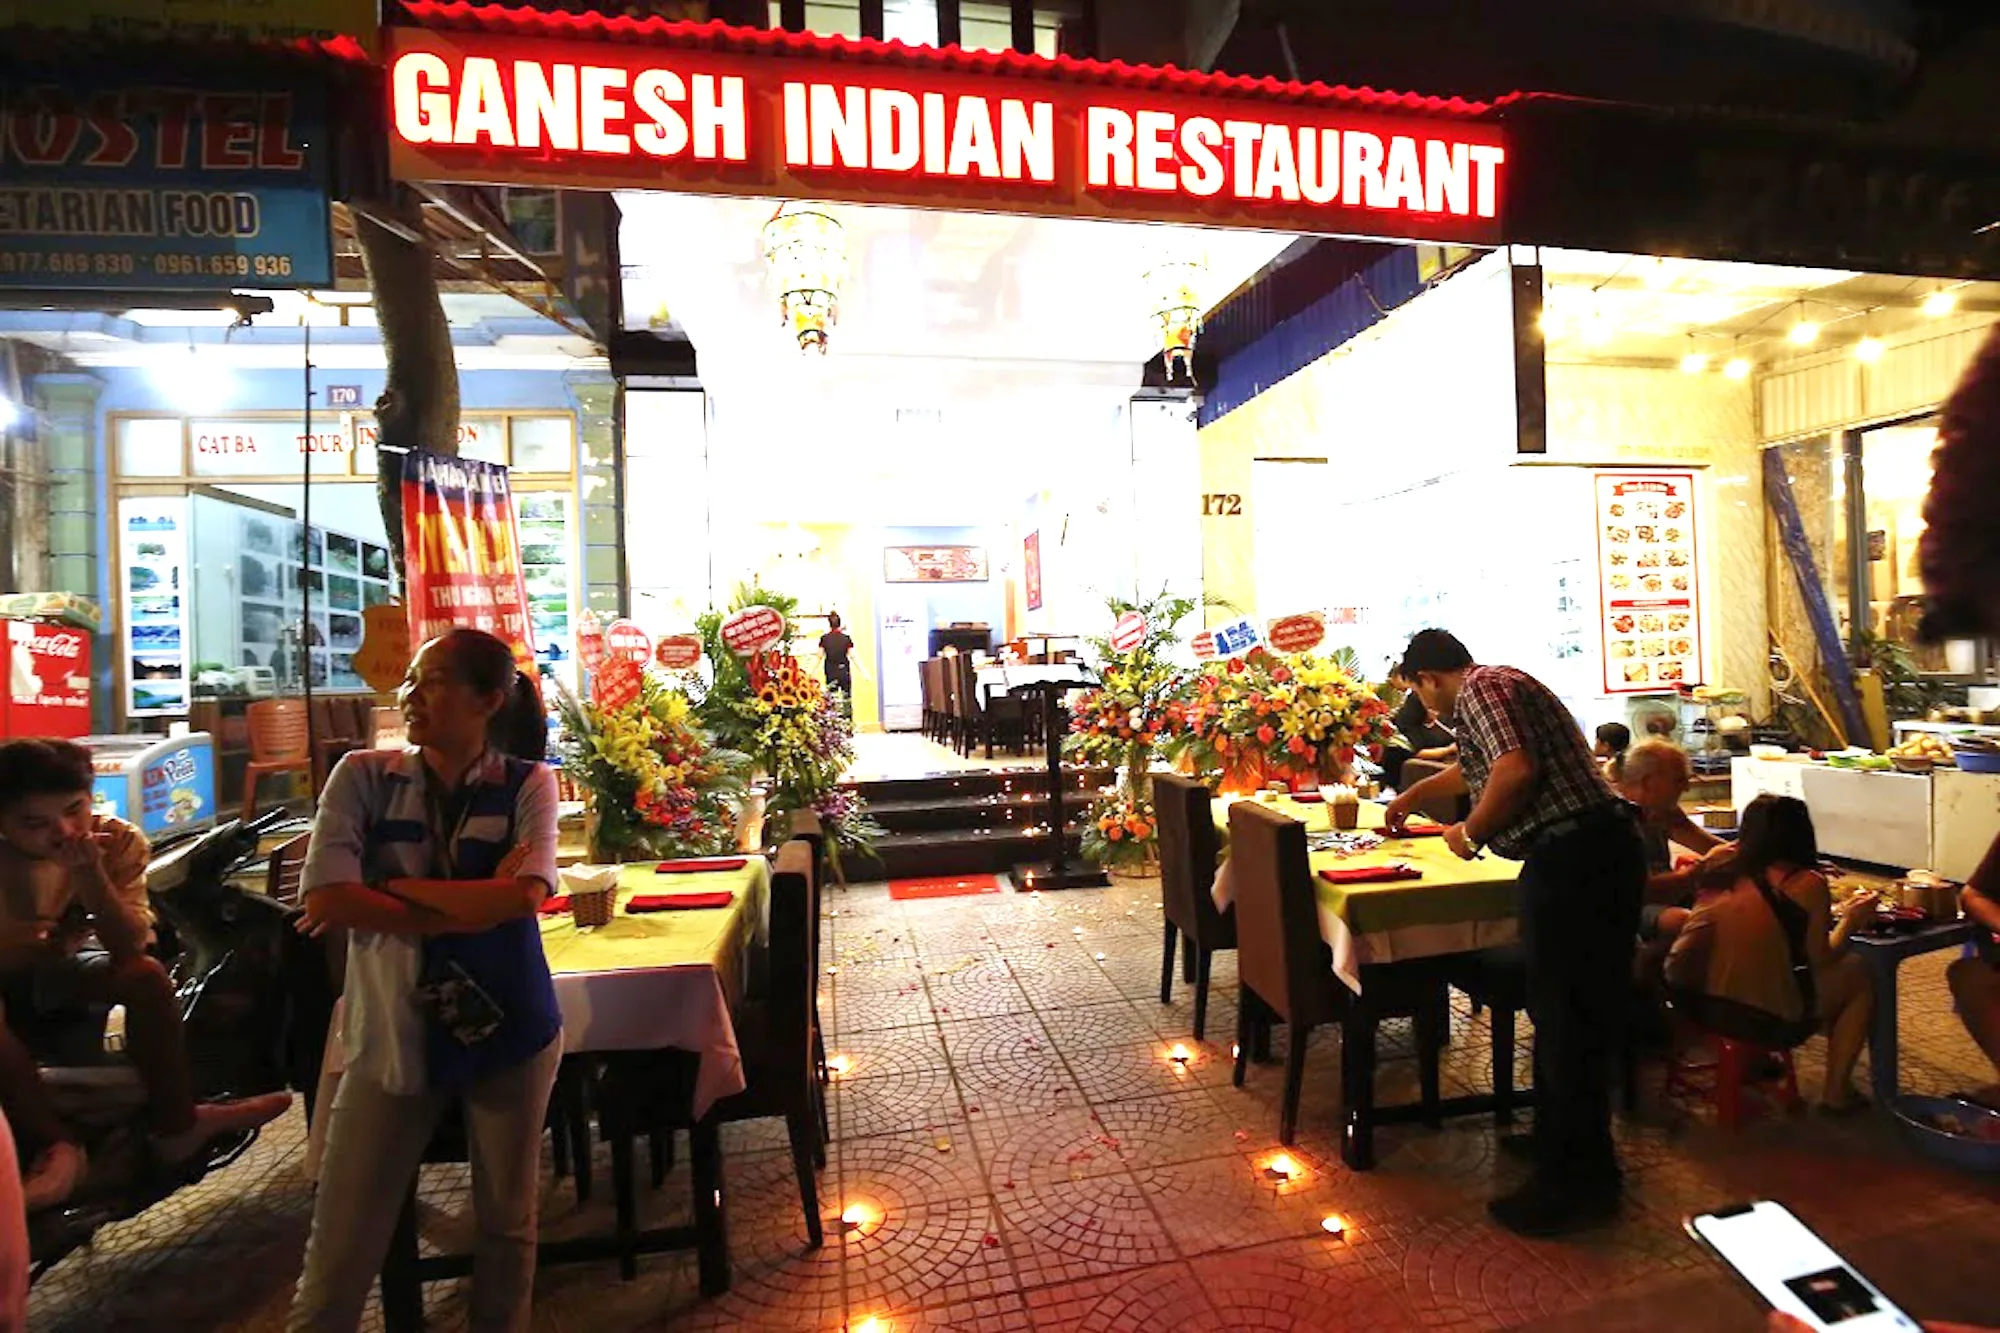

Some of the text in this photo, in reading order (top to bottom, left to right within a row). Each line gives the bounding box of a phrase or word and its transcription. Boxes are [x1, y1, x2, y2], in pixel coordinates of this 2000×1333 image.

[0, 84, 304, 169] OSTEL
[393, 52, 1504, 218] GANESH INDIAN RESTAURANT
[161, 191, 260, 238] FOOD
[254, 255, 292, 276] 936
[332, 388, 355, 403] 170
[296, 434, 343, 453] TOUR
[1201, 493, 1242, 516] 172
